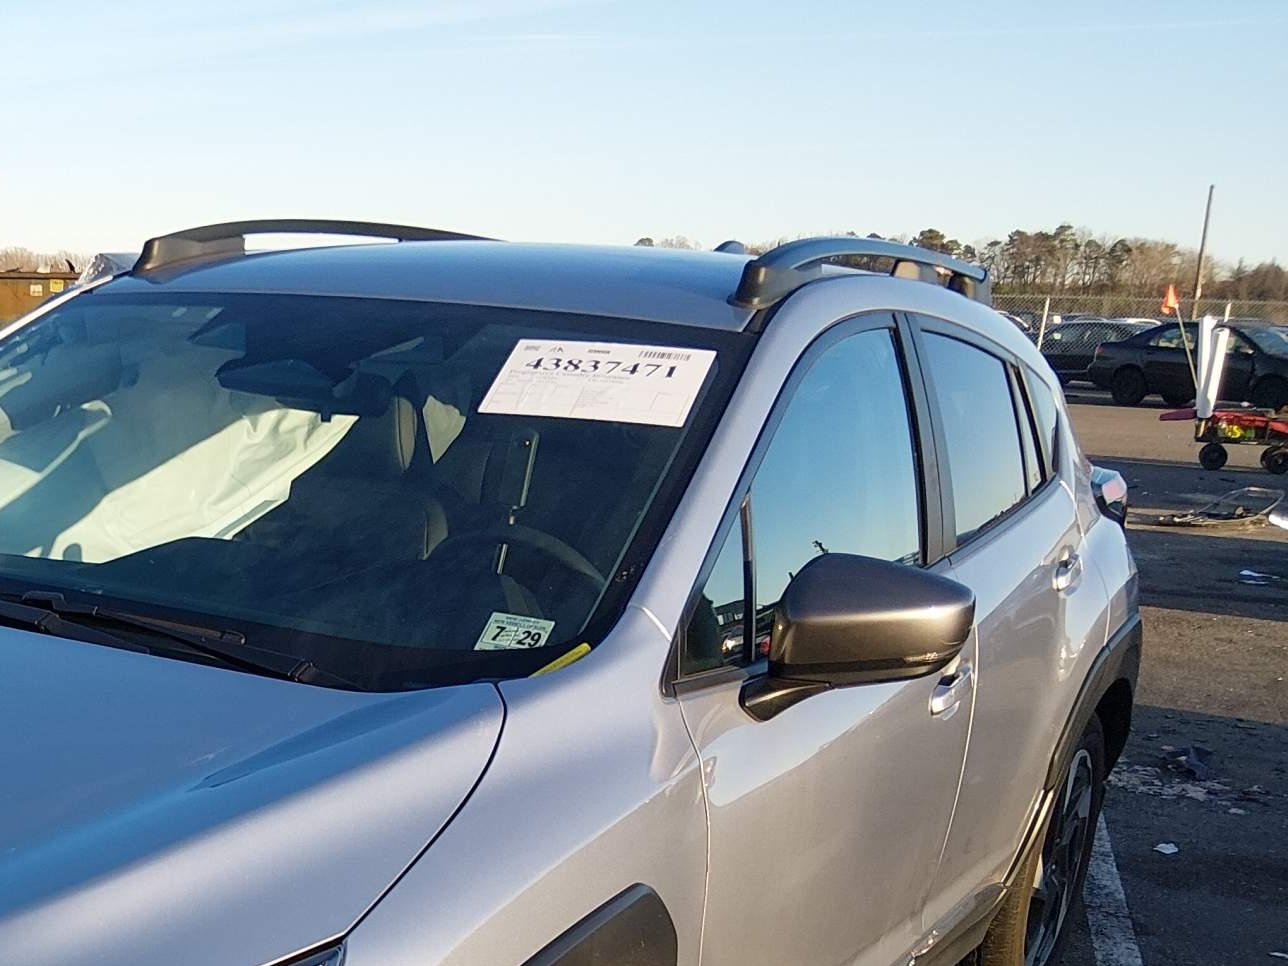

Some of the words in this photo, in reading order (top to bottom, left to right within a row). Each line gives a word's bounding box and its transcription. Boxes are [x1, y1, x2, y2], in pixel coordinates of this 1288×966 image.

[525, 357, 677, 378] 43837471
[491, 625, 507, 641] 7
[516, 630, 542, 647] 29
